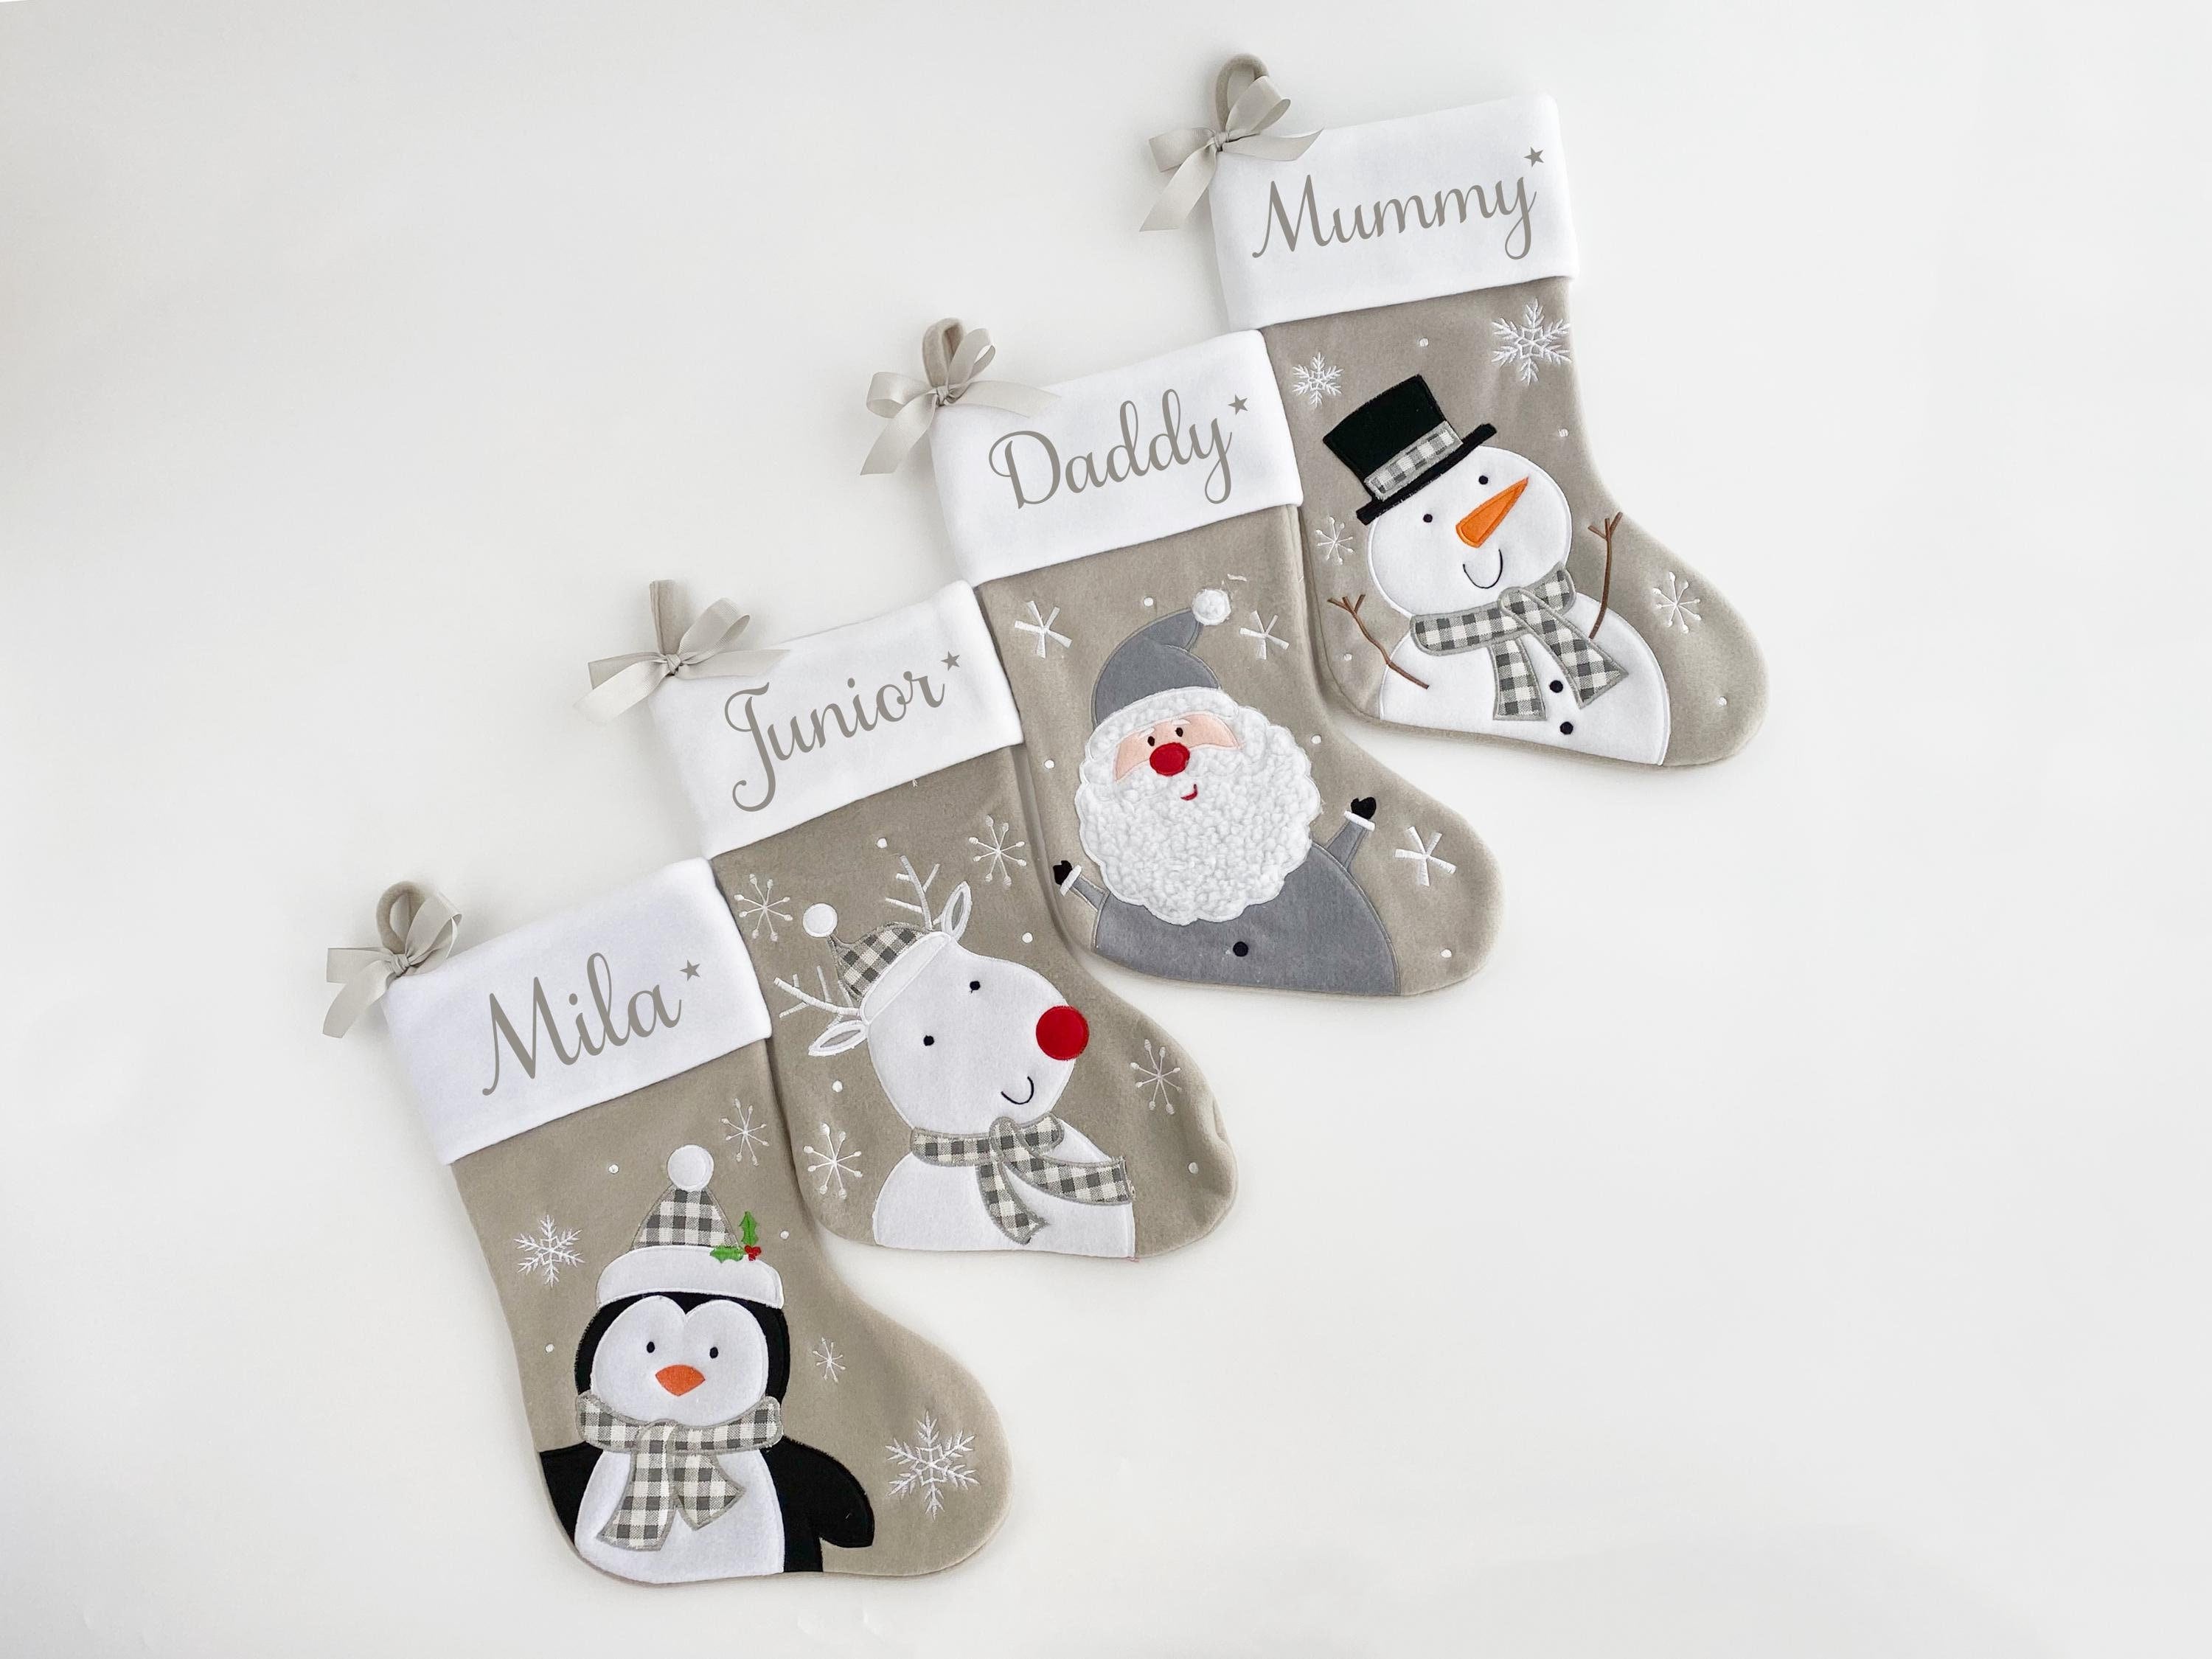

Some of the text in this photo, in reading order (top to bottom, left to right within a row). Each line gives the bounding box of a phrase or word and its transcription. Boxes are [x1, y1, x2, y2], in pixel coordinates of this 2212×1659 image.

[1252, 174, 1537, 260] Mummy
[988, 389, 1233, 509] Daddy
[724, 670, 945, 813] Junior
[481, 952, 682, 1096] Mila
